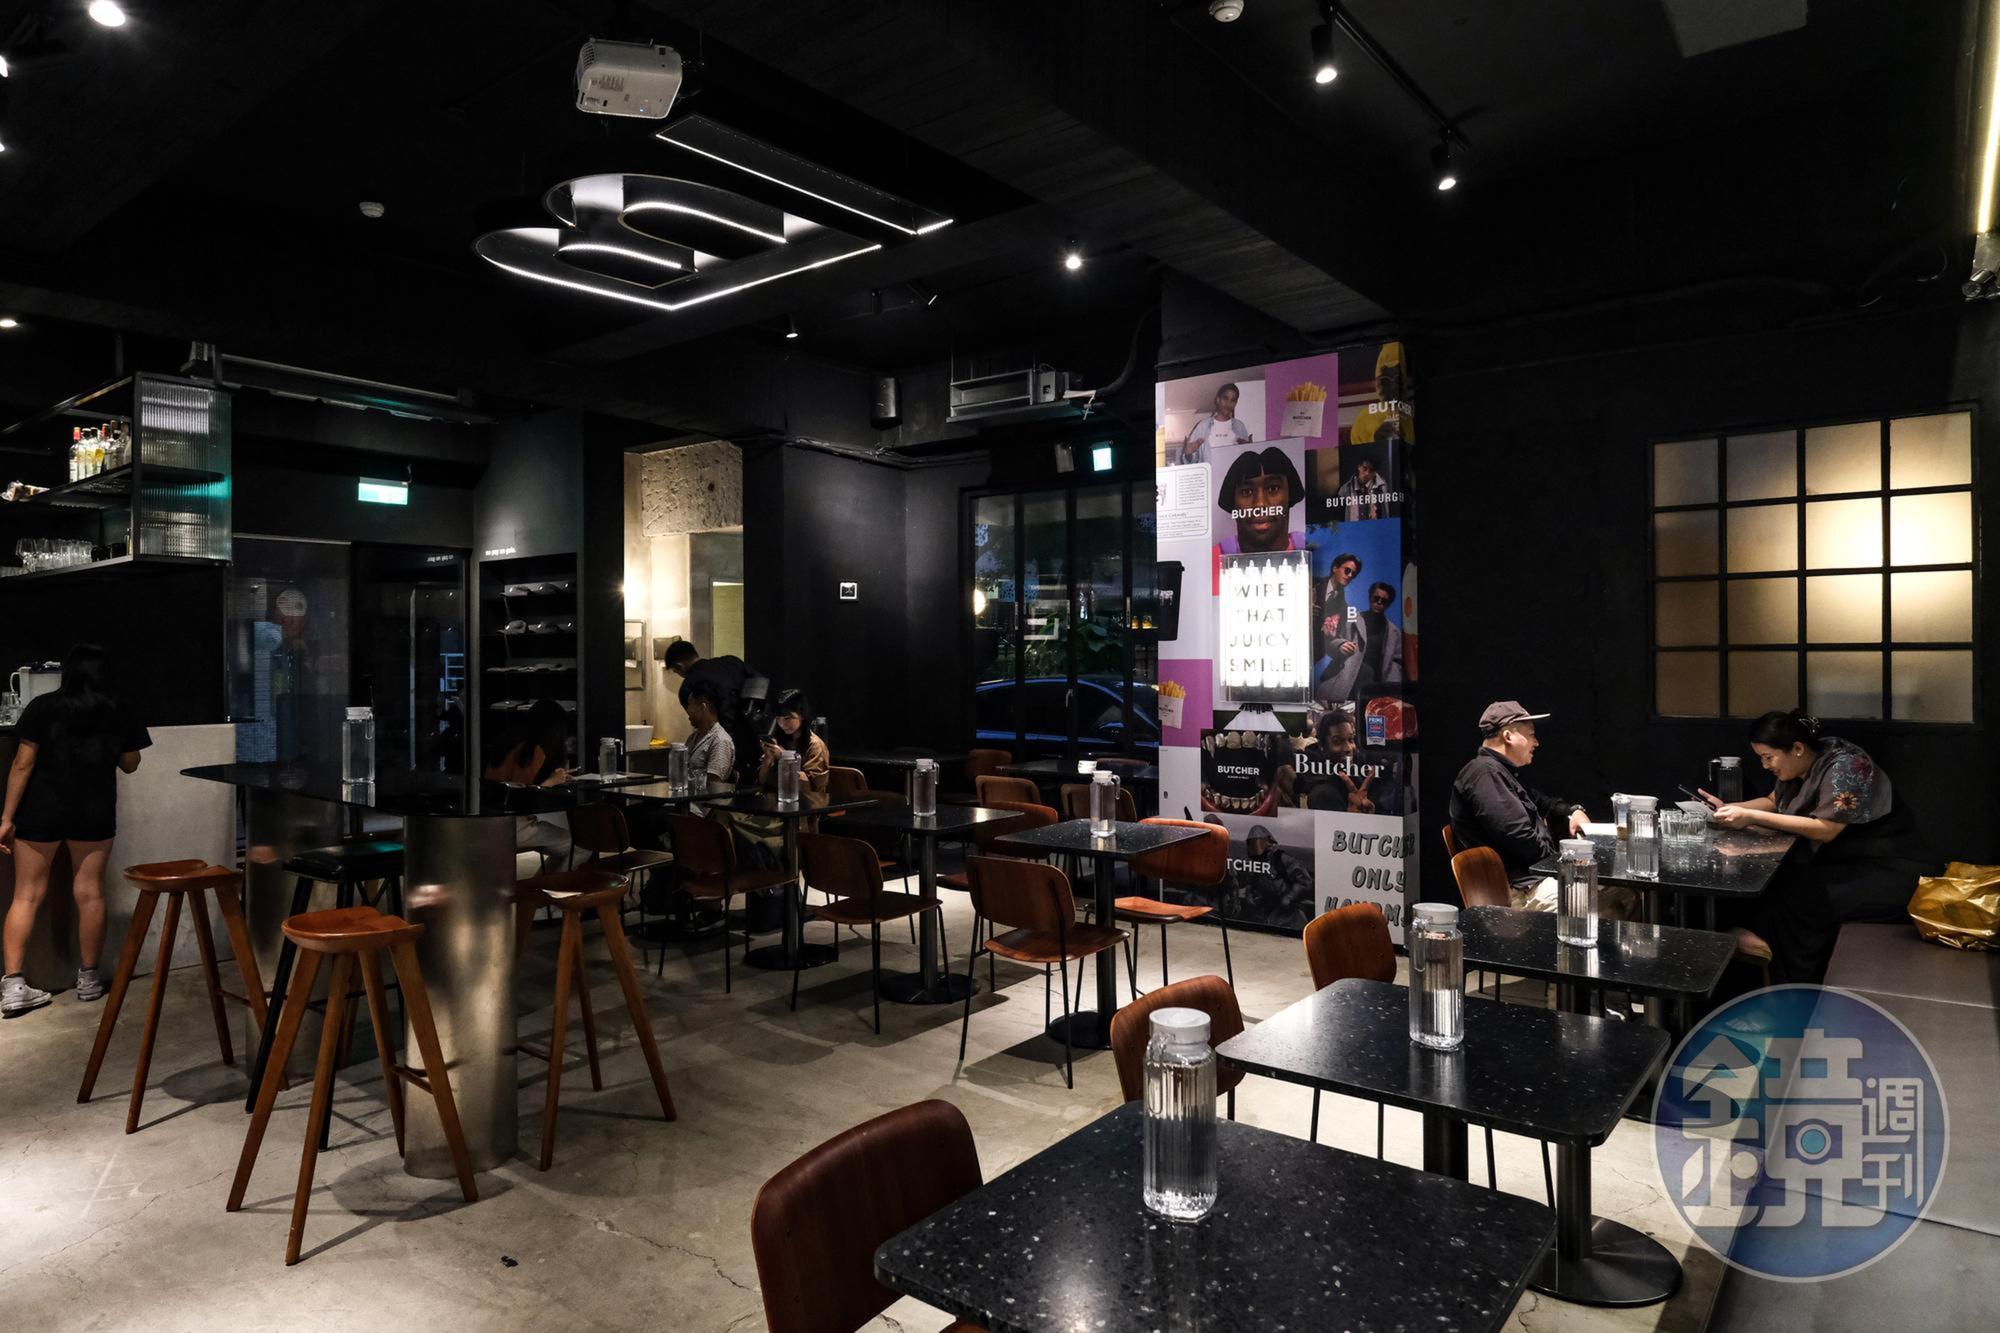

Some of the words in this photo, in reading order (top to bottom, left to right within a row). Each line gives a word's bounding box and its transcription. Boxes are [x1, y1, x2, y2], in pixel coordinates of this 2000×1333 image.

[1231, 505, 1284, 519] BUTCHER
[1234, 583, 1288, 598] WIPE
[1236, 608, 1287, 622] HAT
[1347, 606, 1357, 619] B
[1230, 632, 1292, 648] JUICY
[1217, 765, 1260, 776] BUTCHER
[1295, 753, 1385, 778] Butcher
[1226, 857, 1271, 875] TCHER
[1351, 865, 1406, 893] ONLY
